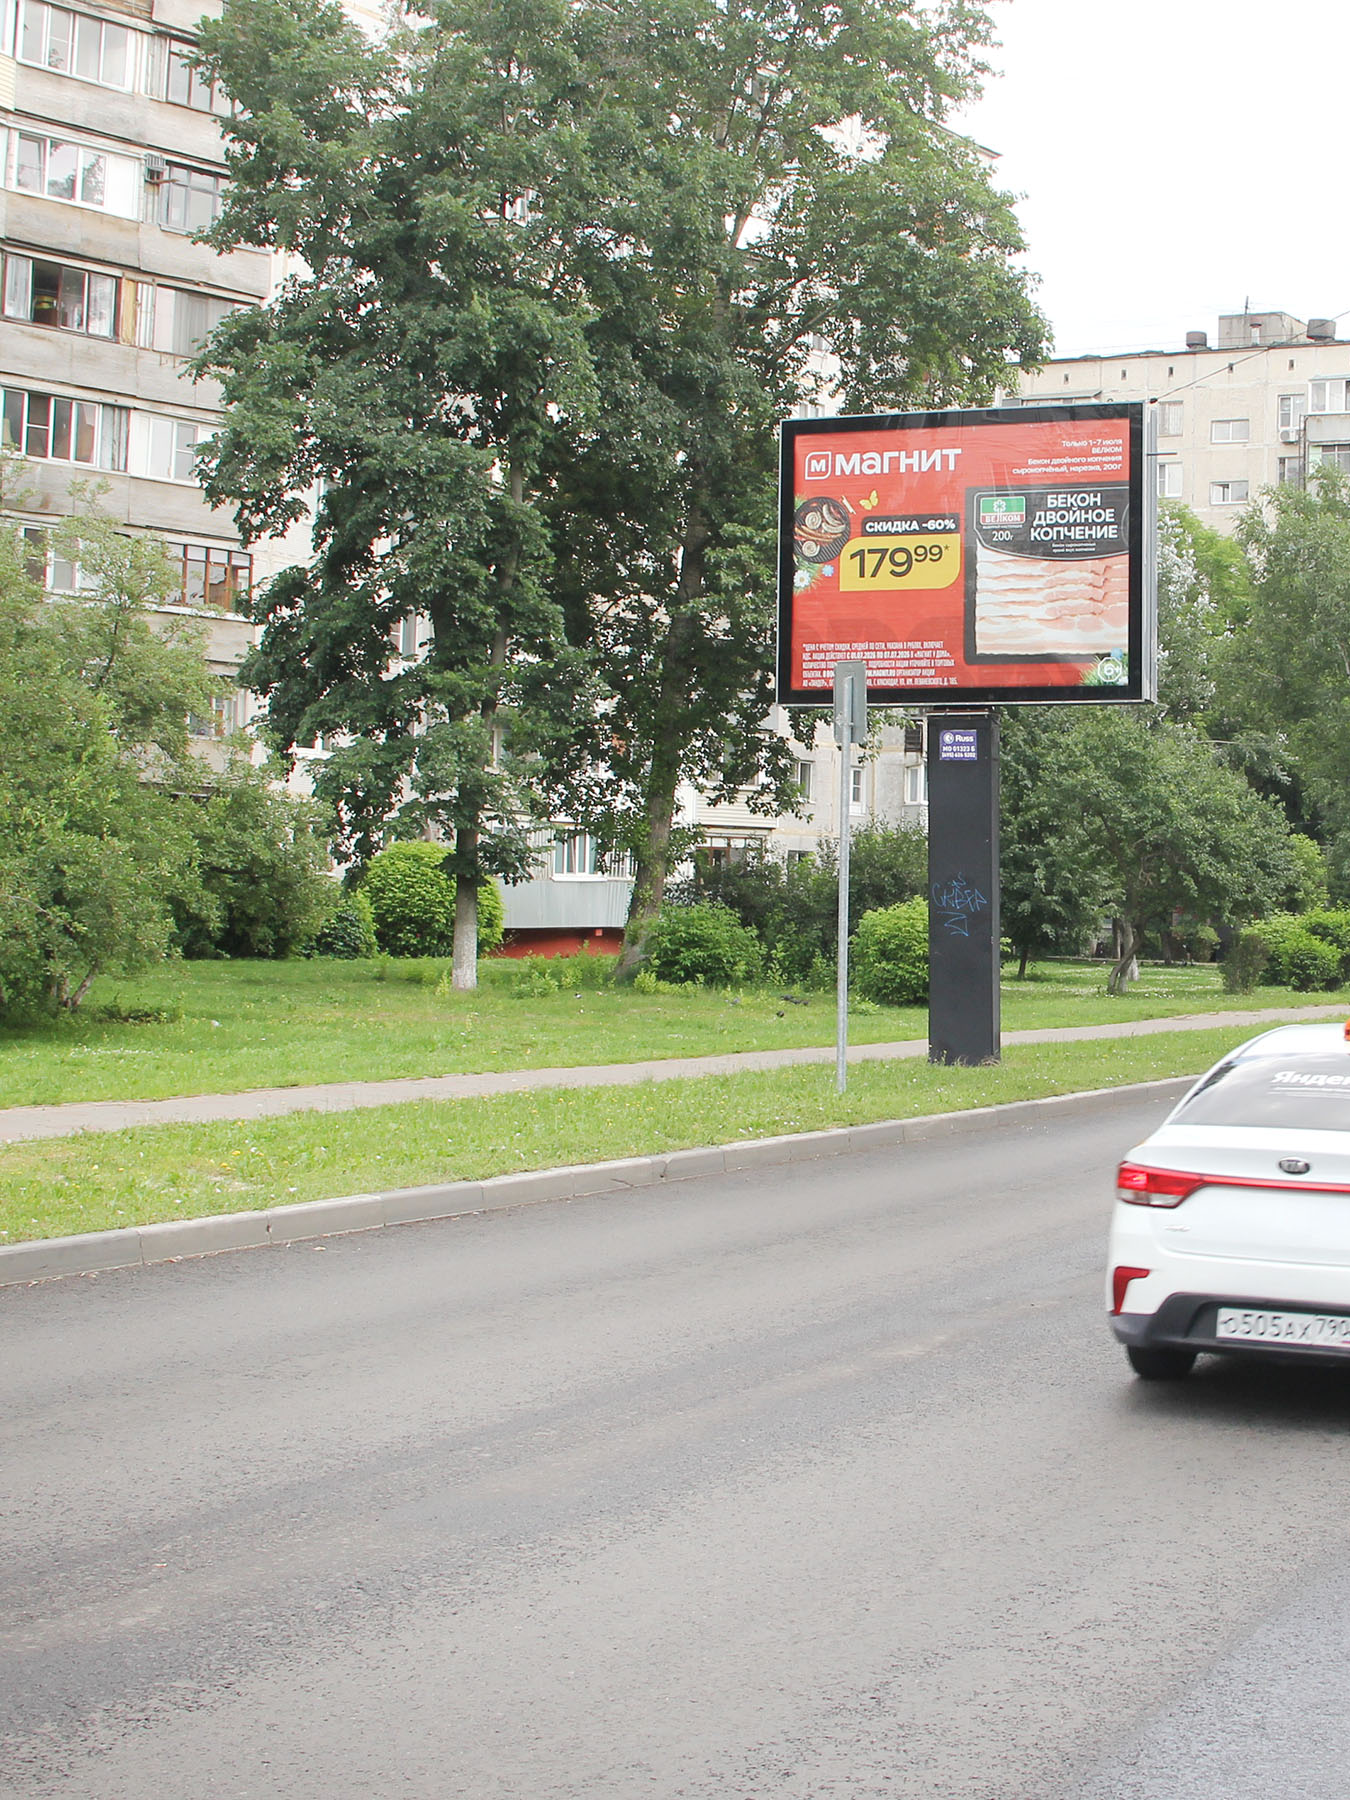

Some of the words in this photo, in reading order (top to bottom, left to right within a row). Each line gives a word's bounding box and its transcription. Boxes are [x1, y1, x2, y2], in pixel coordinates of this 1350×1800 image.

[1092, 446, 1122, 454] ВЕЛКОМ
[1047, 492, 1101, 508] БЕКОН
[985, 515, 1021, 523] ВЕЛКОМ
[1033, 506, 1115, 527] ДВОЙНОЕ
[865, 521, 919, 533] СКИДКА
[922, 519, 956, 531] -60%
[1030, 525, 1118, 541] КОПЧЕНИЕ
[850, 547, 913, 578] 179
[955, 734, 974, 742] Russ
